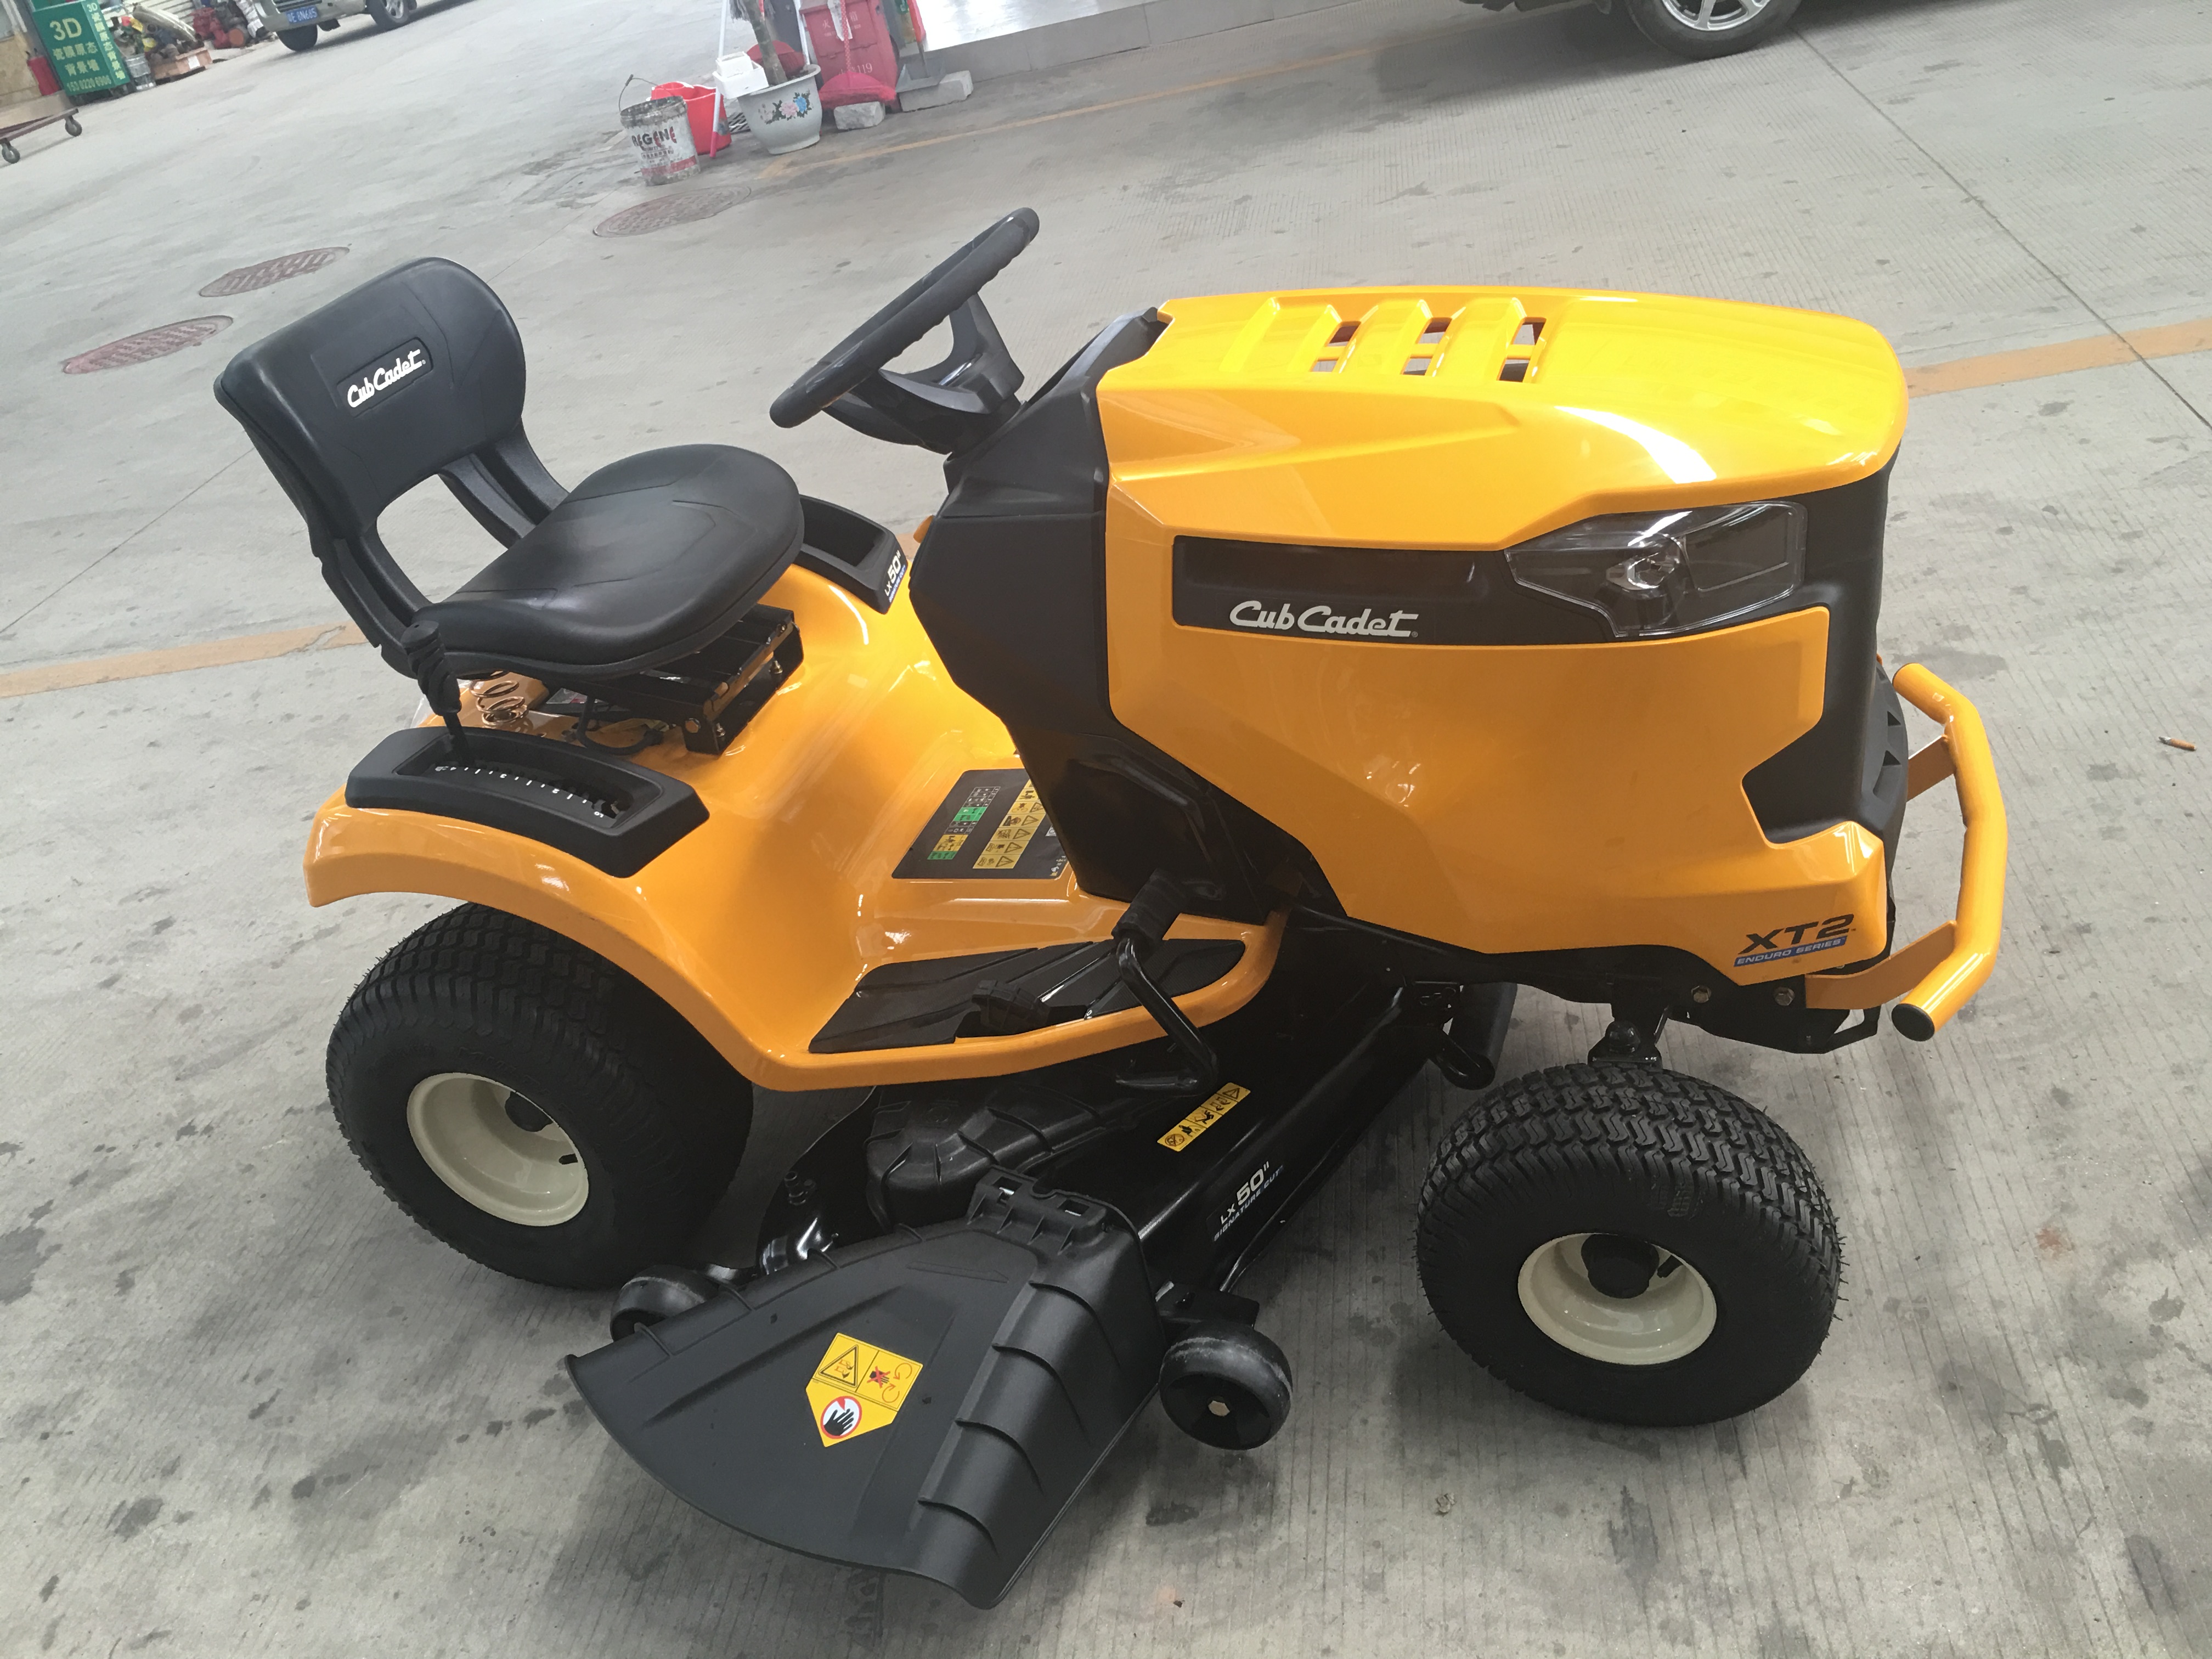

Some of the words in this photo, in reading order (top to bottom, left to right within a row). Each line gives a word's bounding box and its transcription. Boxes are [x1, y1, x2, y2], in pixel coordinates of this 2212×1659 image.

[87, 3, 98, 12] 3D
[49, 18, 82, 41] 3D
[347, 377, 375, 408] Cub
[373, 349, 422, 391] Cadet
[884, 581, 893, 596] LX
[1229, 600, 1295, 630] Cub
[1297, 605, 1419, 637] Cadet
[1737, 913, 1854, 955] XT2
[1737, 950, 1791, 965] ENDURO
[1796, 939, 1841, 953] SERIES
[1214, 1188, 1261, 1242] SIGNATURE
[1264, 1169, 1280, 1188] CUT
[1220, 1203, 1236, 1224] LX
